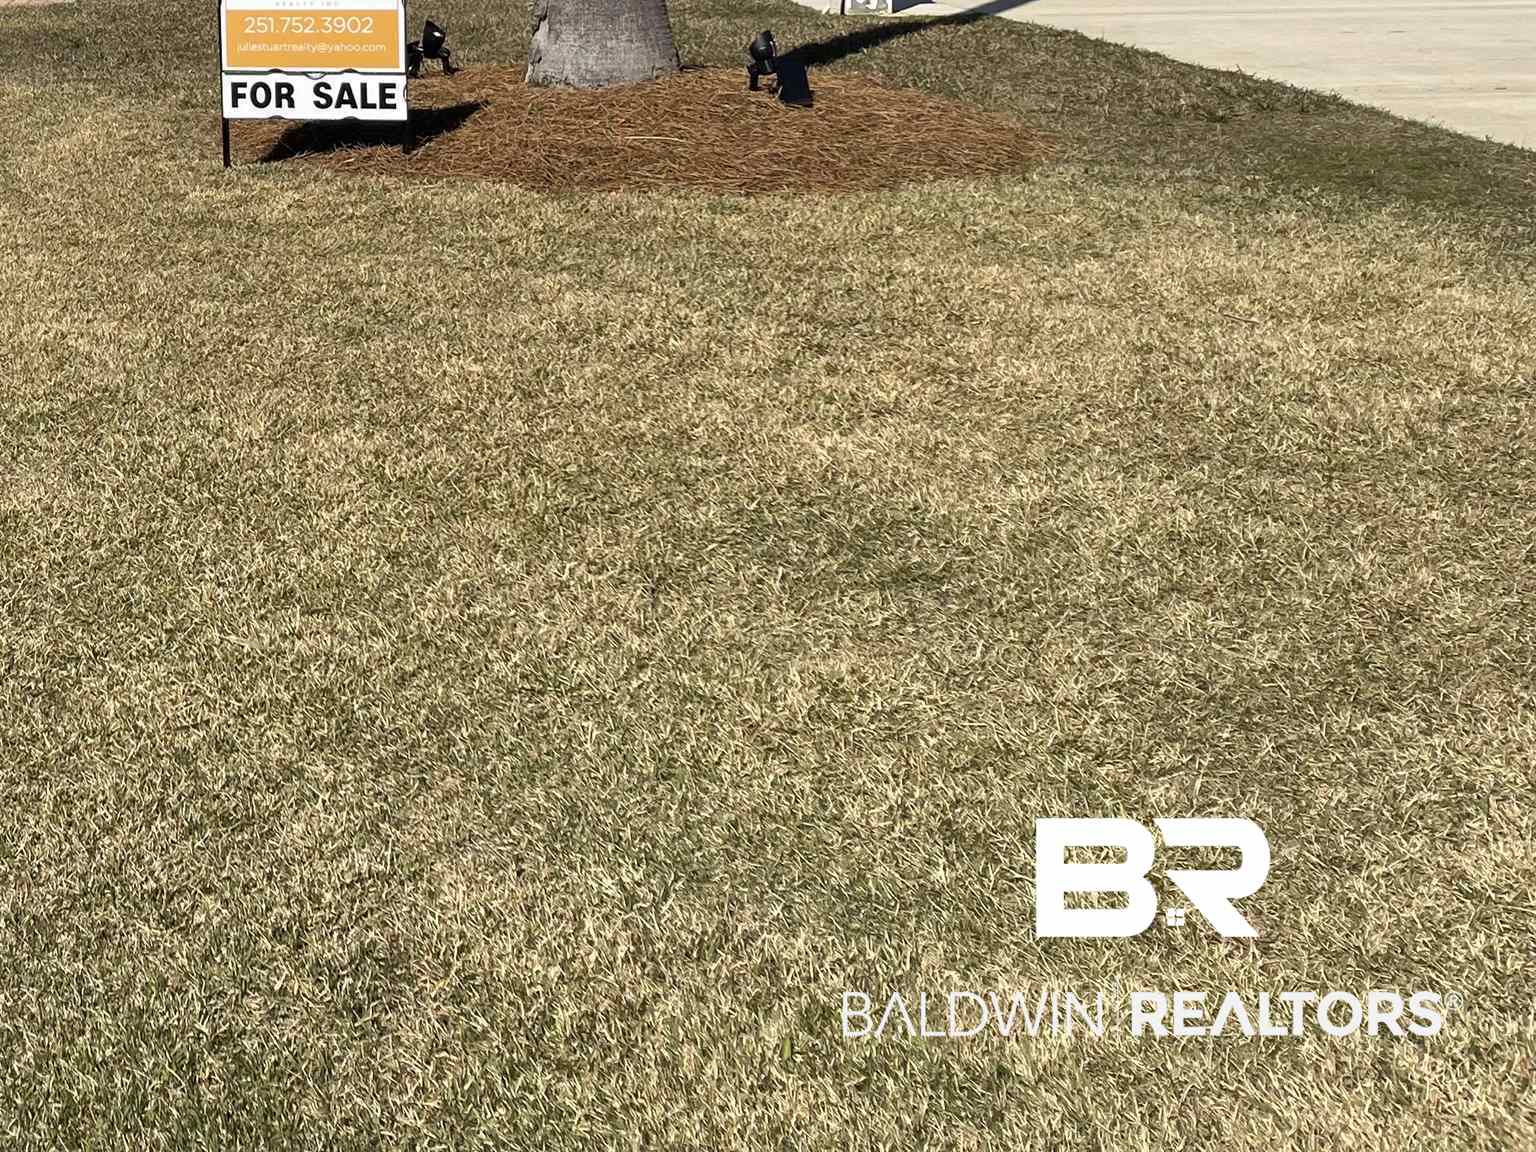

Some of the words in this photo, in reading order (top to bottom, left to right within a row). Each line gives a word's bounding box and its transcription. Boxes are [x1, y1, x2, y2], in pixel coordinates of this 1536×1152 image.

[243, 16, 374, 34] 251.752.3902
[231, 81, 296, 109] FOR
[312, 81, 397, 109] SALE
